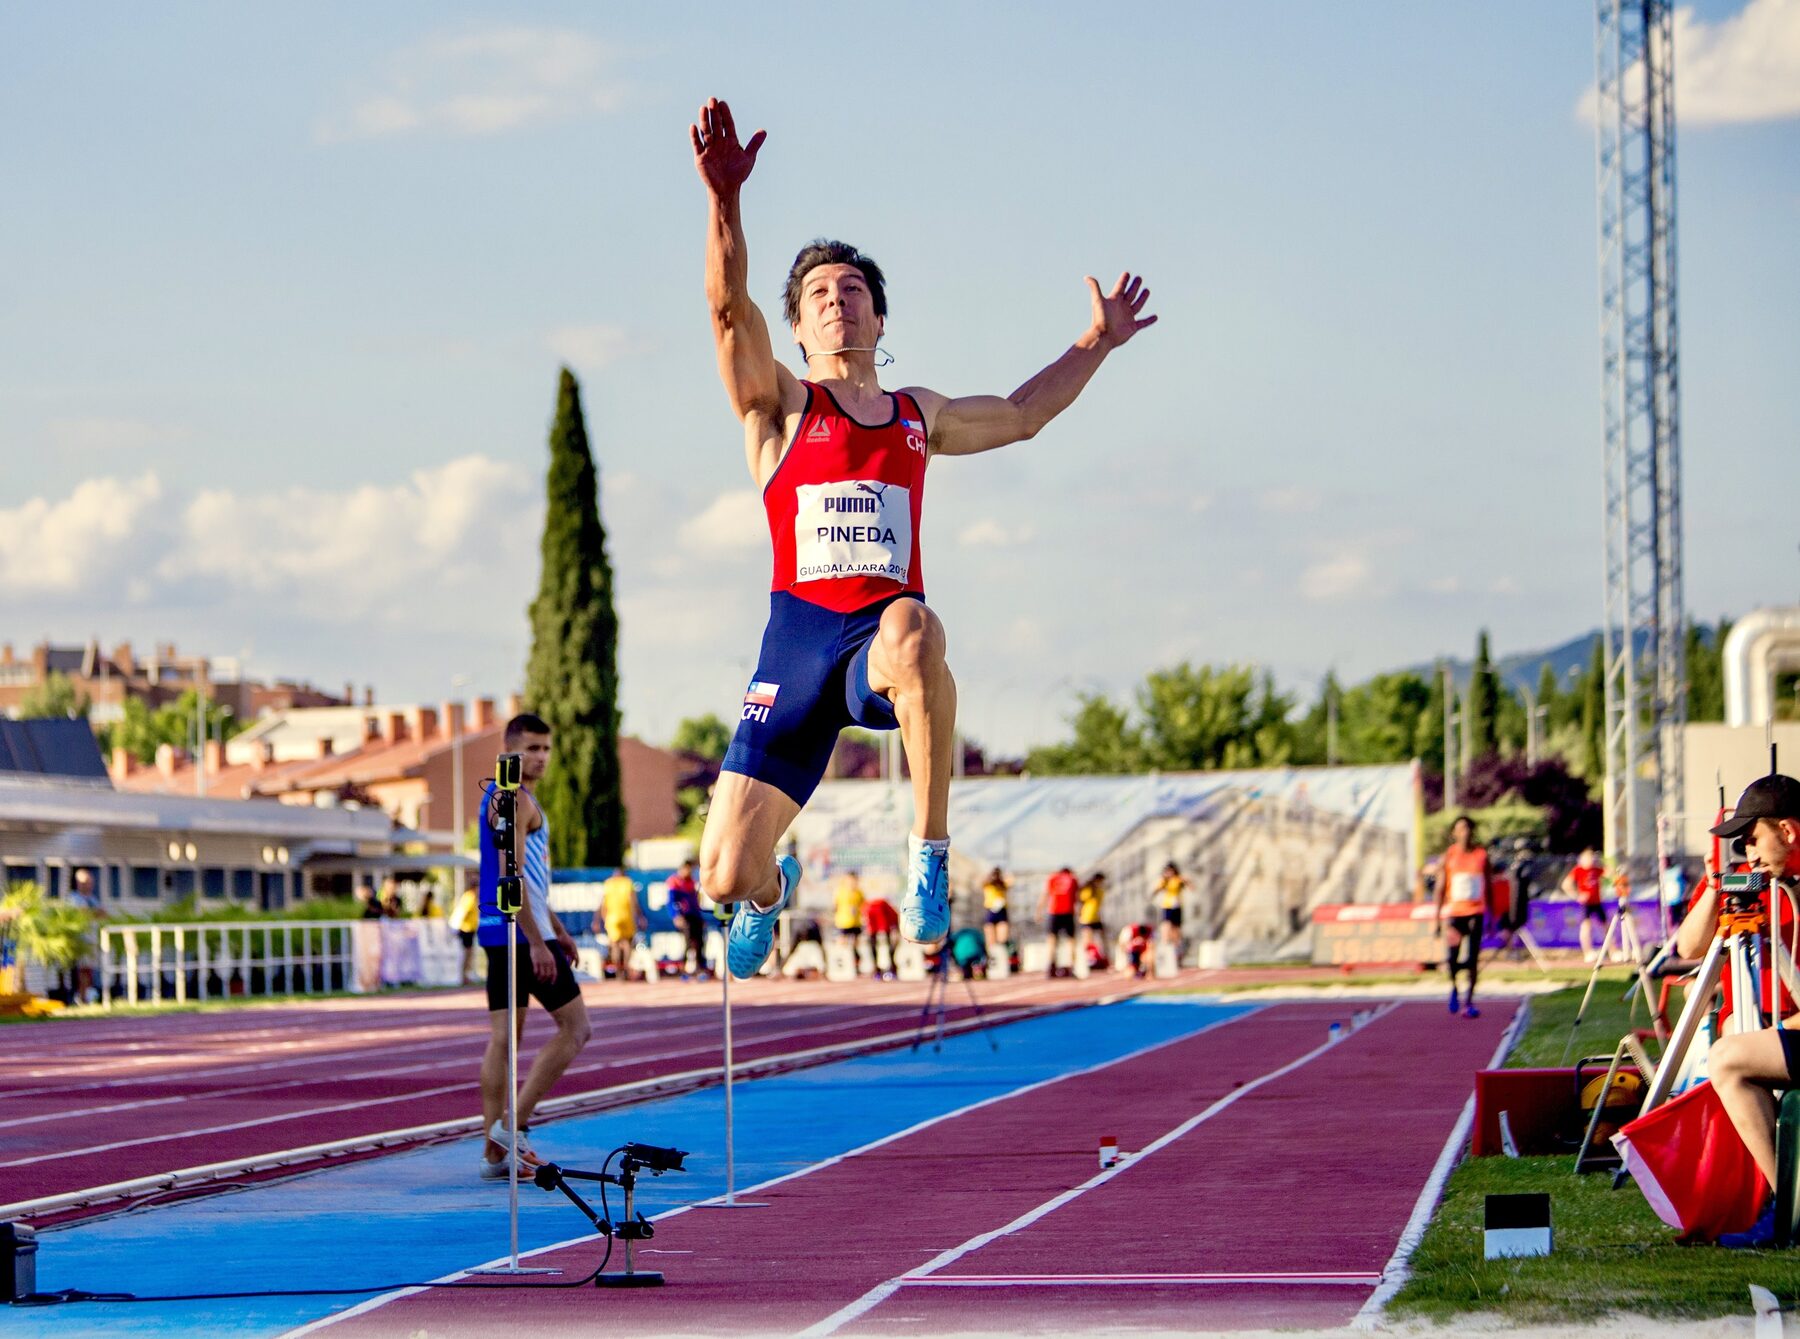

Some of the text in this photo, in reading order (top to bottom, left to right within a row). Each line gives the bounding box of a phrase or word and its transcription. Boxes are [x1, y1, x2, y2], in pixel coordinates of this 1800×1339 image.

[906, 434, 926, 458] CHI
[824, 497, 876, 513] PUMA
[817, 526, 897, 544] PINEDA
[800, 564, 886, 577] GUADALAJARA
[741, 704, 770, 723] CHI
